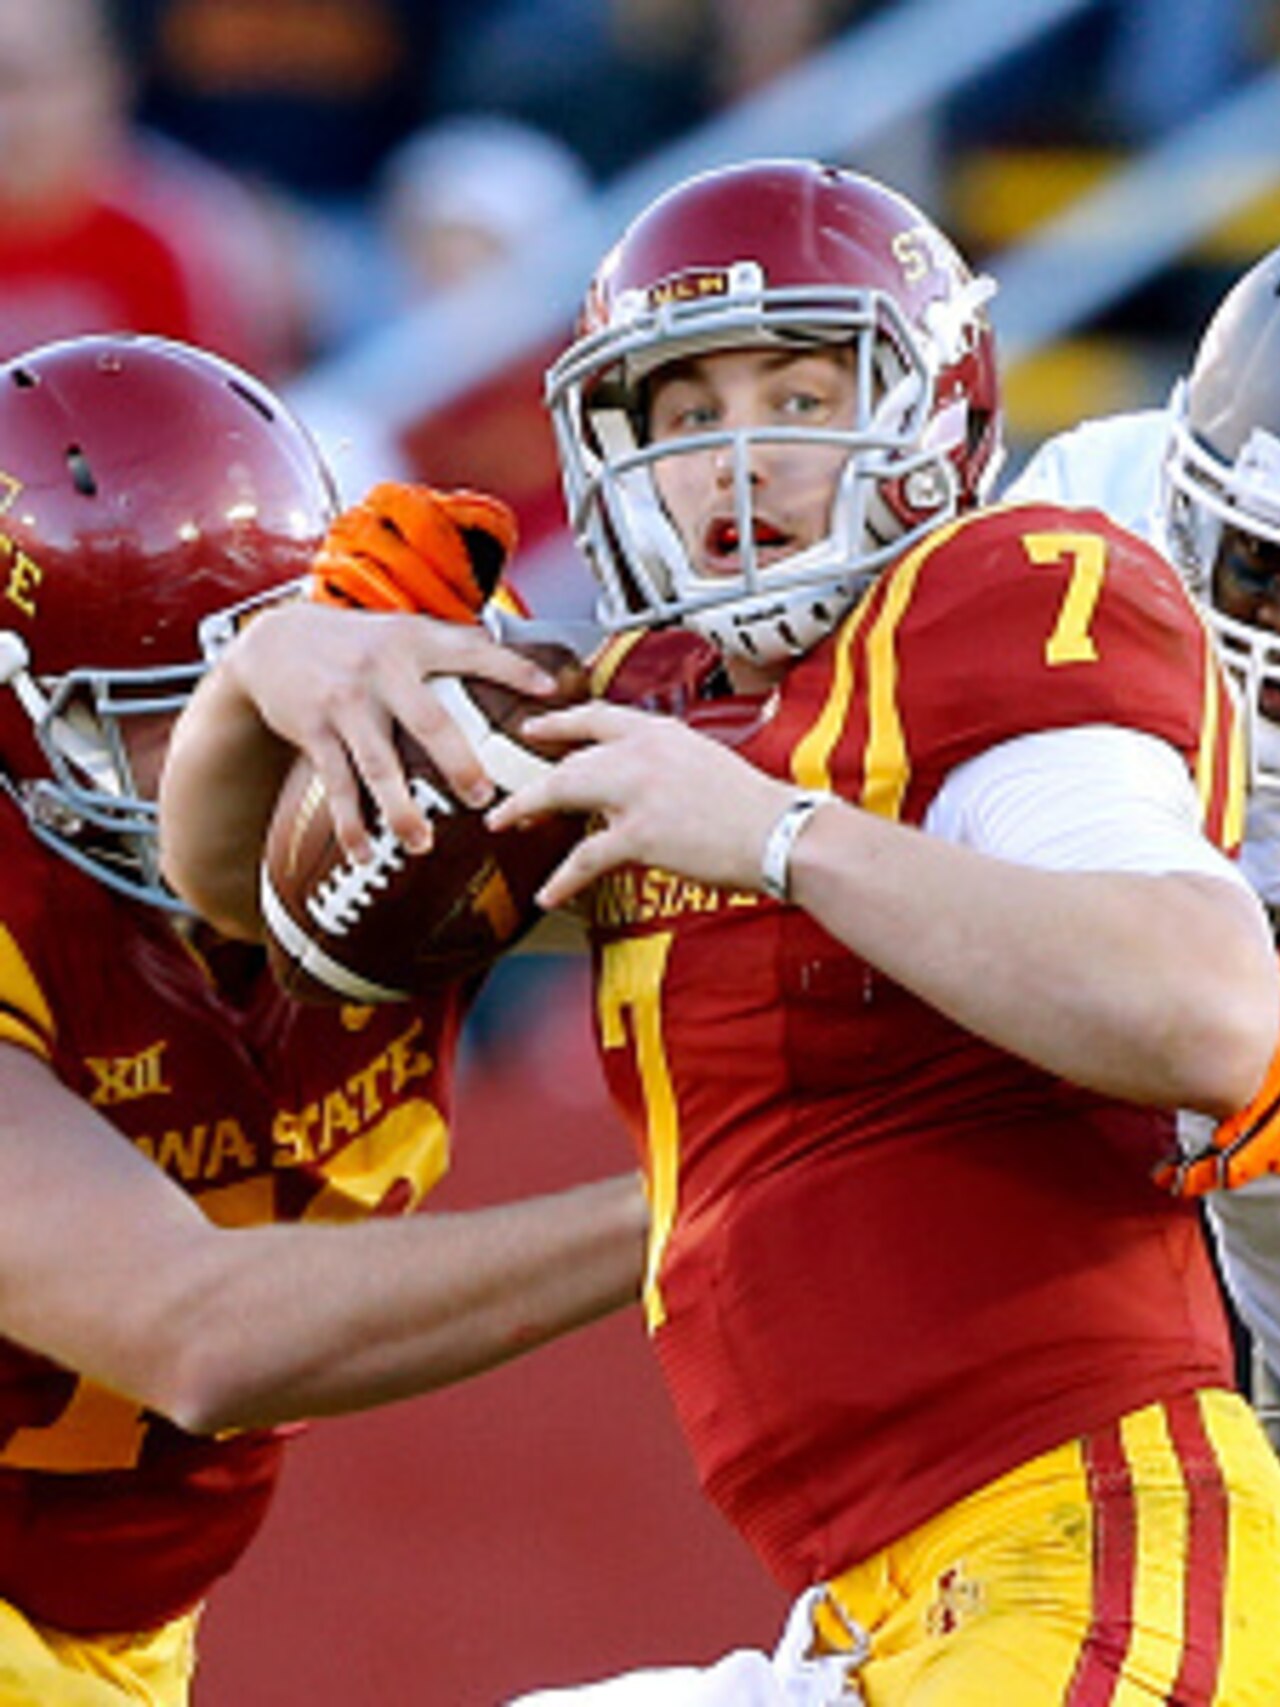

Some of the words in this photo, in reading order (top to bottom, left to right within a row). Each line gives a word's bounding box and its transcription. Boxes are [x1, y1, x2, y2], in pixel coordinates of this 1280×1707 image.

[1021, 533, 1106, 666] 7
[84, 1040, 172, 1106] XII
[132, 1118, 257, 1180] WA
[271, 1017, 434, 1168] STATE
[598, 934, 681, 1338] 7
